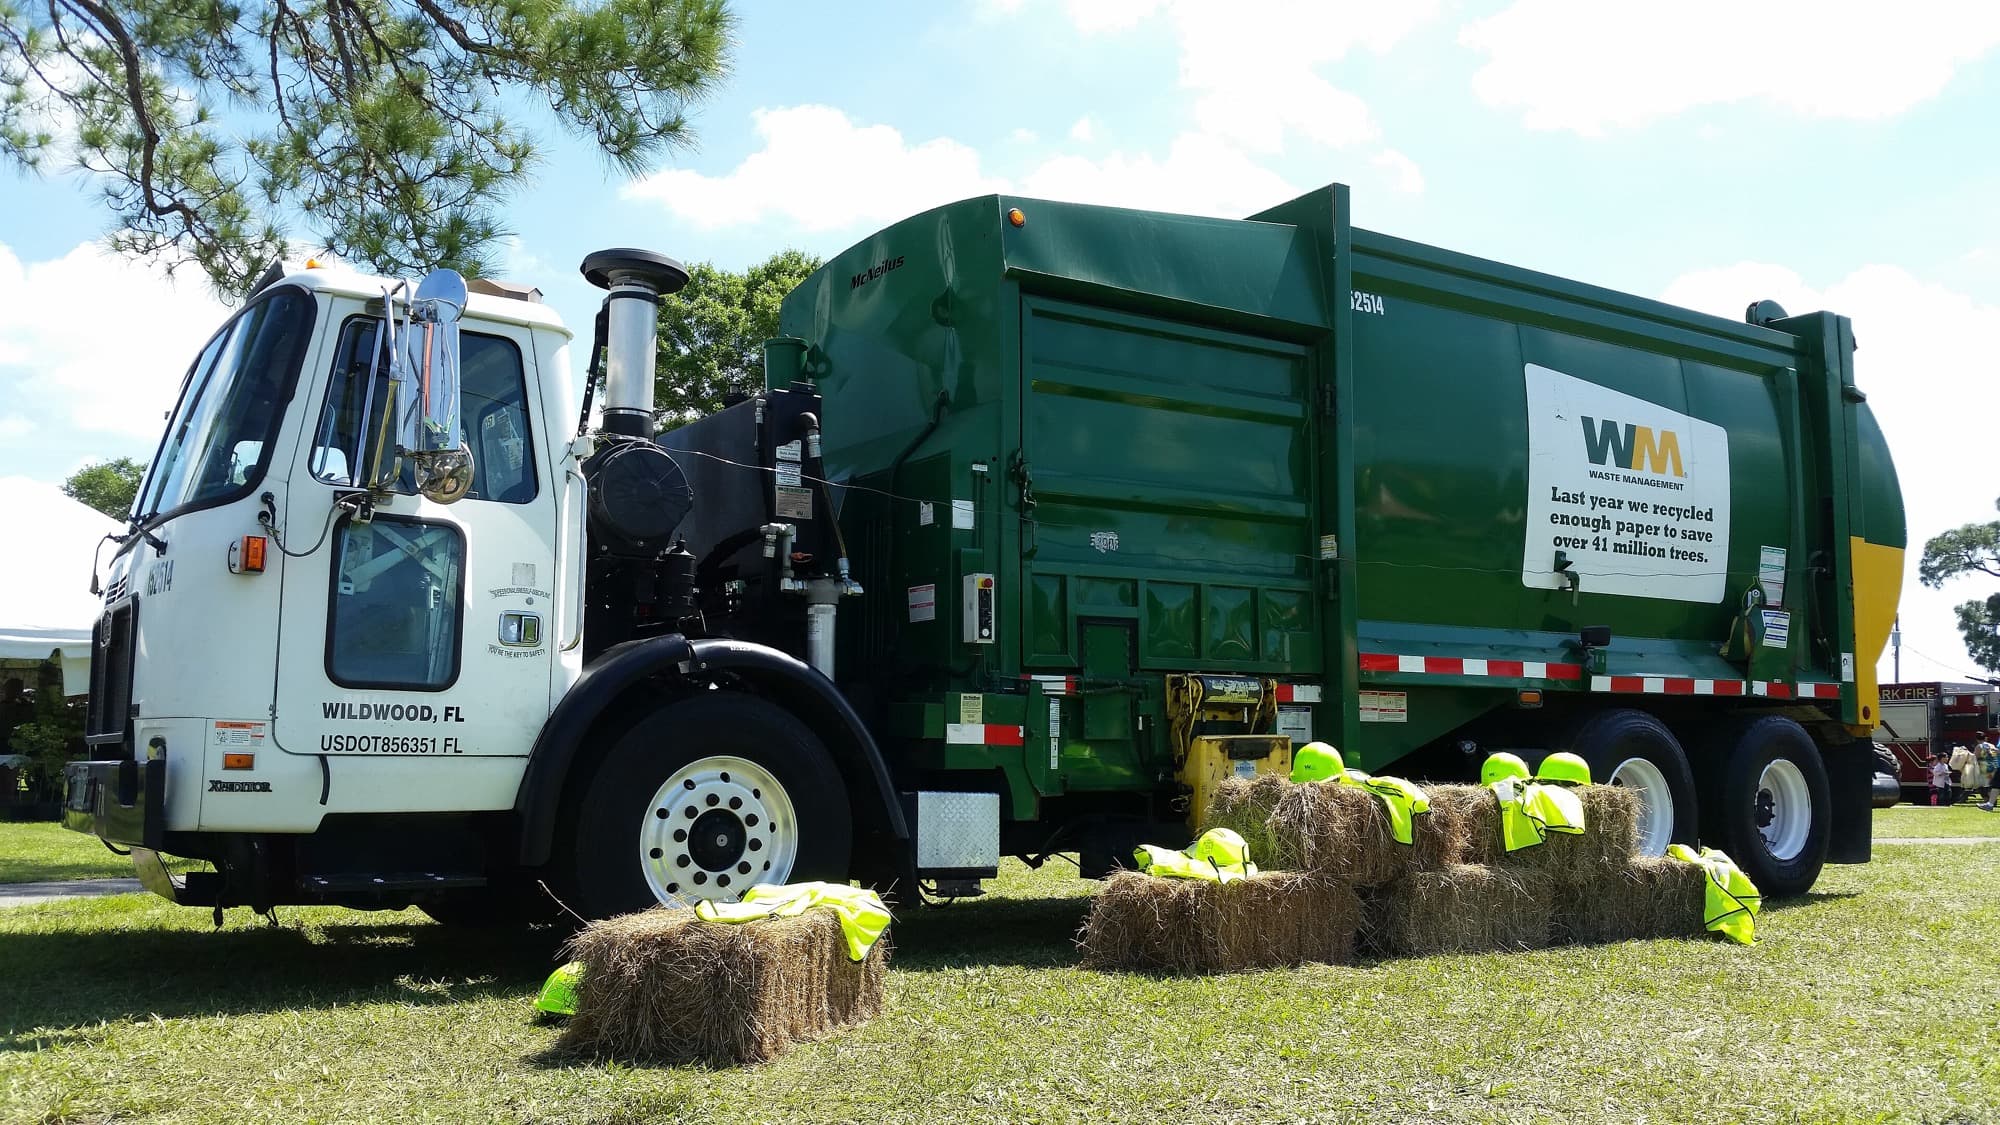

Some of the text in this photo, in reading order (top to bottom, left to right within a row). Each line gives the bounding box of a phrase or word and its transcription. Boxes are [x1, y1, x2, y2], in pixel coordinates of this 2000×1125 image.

[851, 256, 904, 289] McNeilus
[1580, 415, 1684, 478] WM
[1589, 470, 1684, 491] WASTE MANAGEMENT
[1551, 486, 1714, 522] Last year we recycled
[1550, 513, 1713, 542] enough paper to save
[1553, 535, 1708, 563] over 41 million trees.
[1879, 688, 1934, 700] RK FIRE
[322, 702, 464, 723] WILDWOOD, FL
[320, 735, 463, 753] USDOT856351 FL
